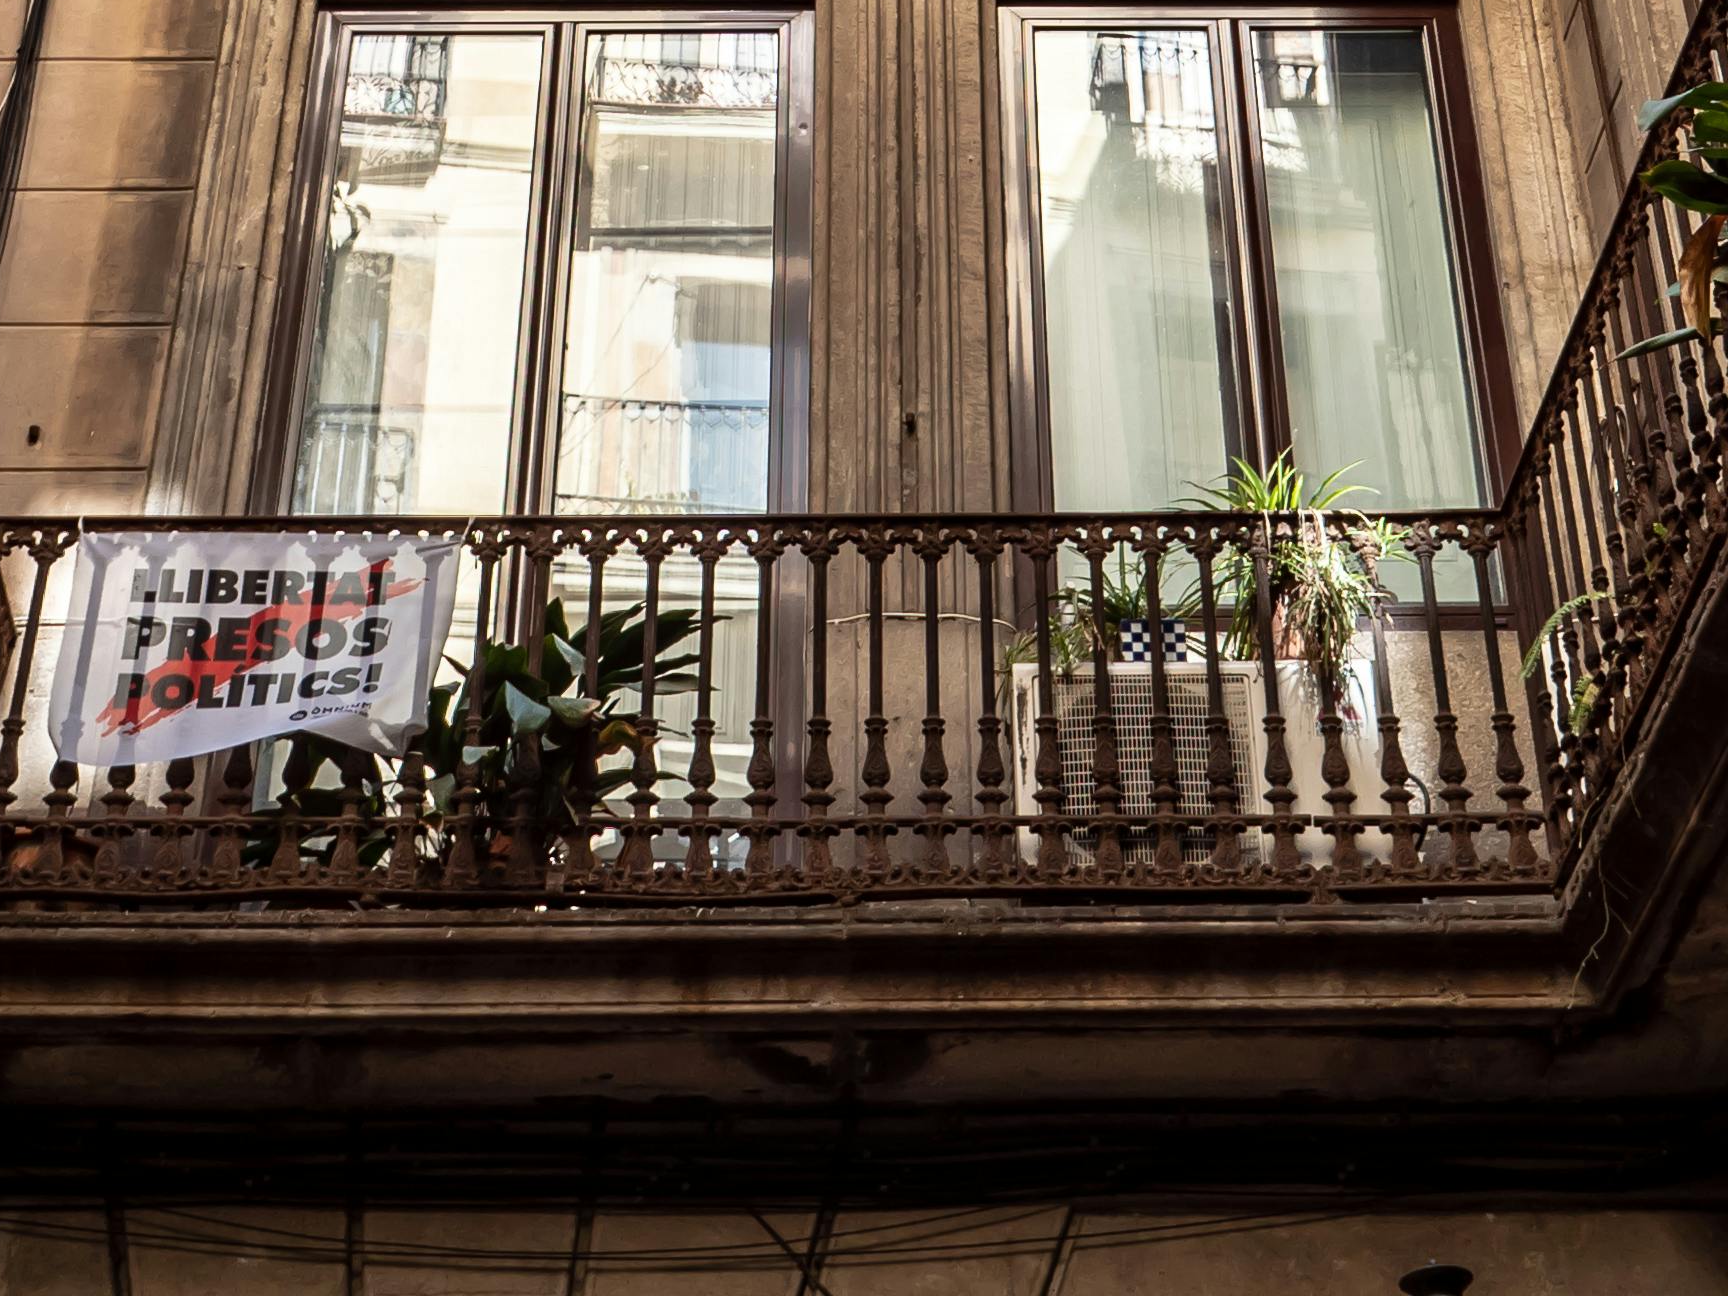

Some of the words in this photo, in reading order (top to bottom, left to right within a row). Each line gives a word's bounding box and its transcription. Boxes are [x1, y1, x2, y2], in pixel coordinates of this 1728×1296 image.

[130, 569, 396, 605] LLIBERTAT
[121, 616, 393, 661] PRESOS
[112, 662, 384, 710] POLÍTICS!
